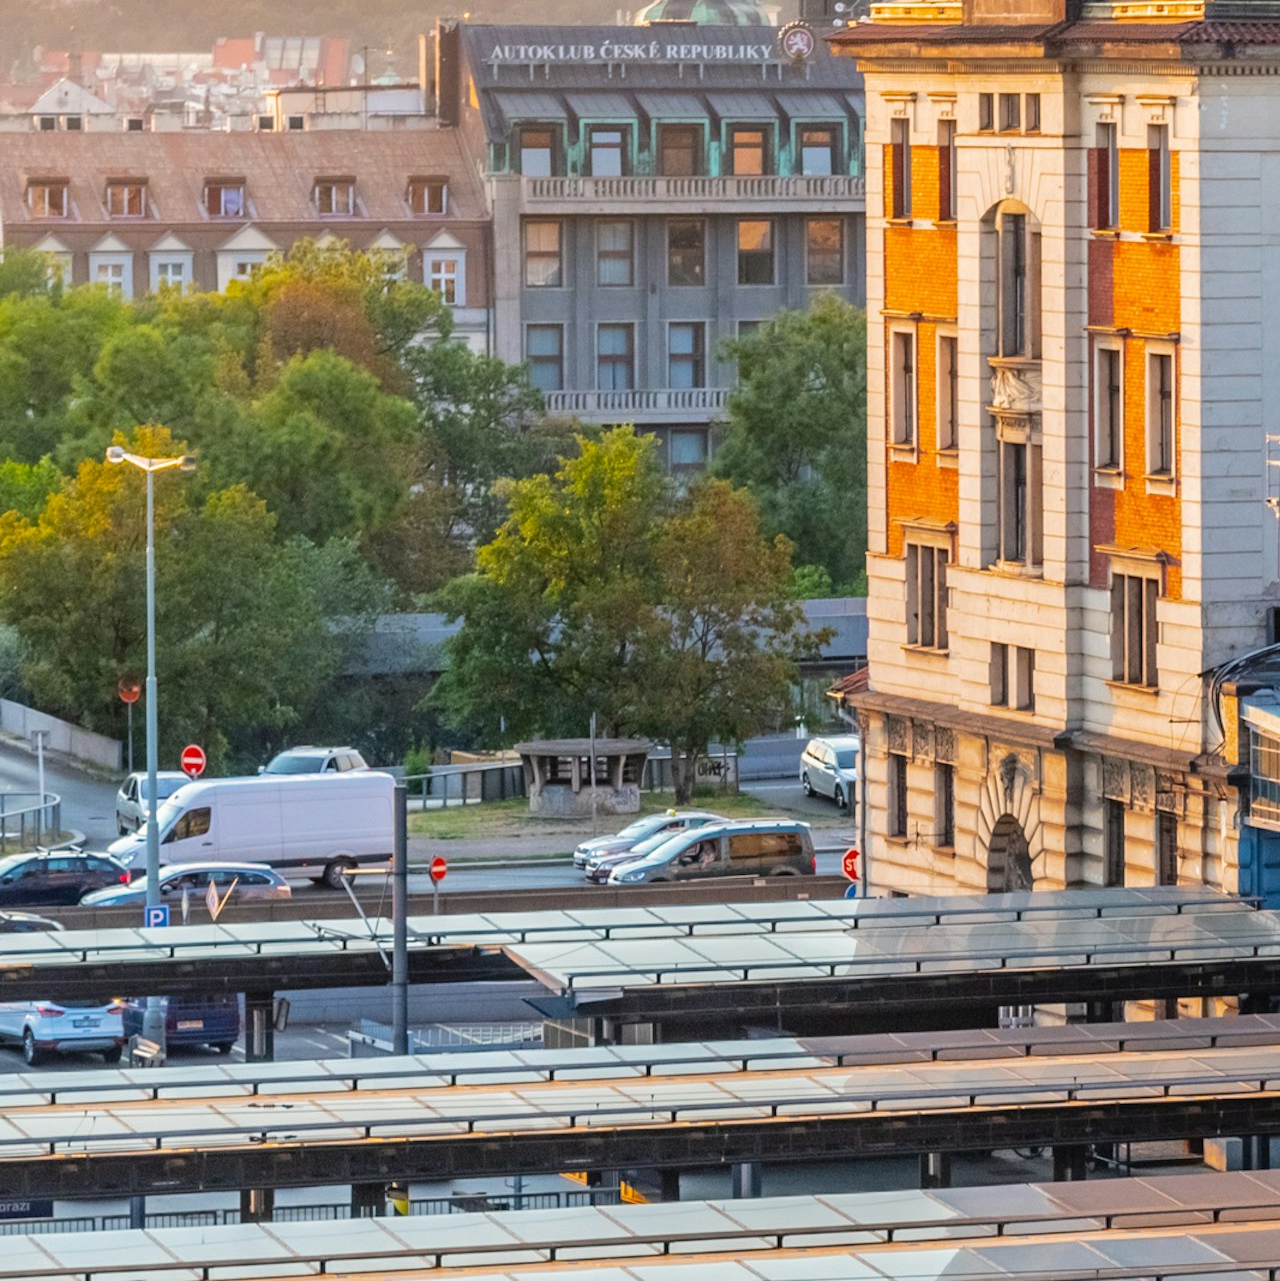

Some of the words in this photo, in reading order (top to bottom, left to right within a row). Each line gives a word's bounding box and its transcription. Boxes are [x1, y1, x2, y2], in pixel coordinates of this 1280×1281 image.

[491, 44, 595, 60] AUTOKLUB
[600, 39, 661, 60] ČESKÉ
[666, 44, 774, 61] REPUBLIKY
[845, 858, 857, 872] ST
[150, 909, 164, 927] P
